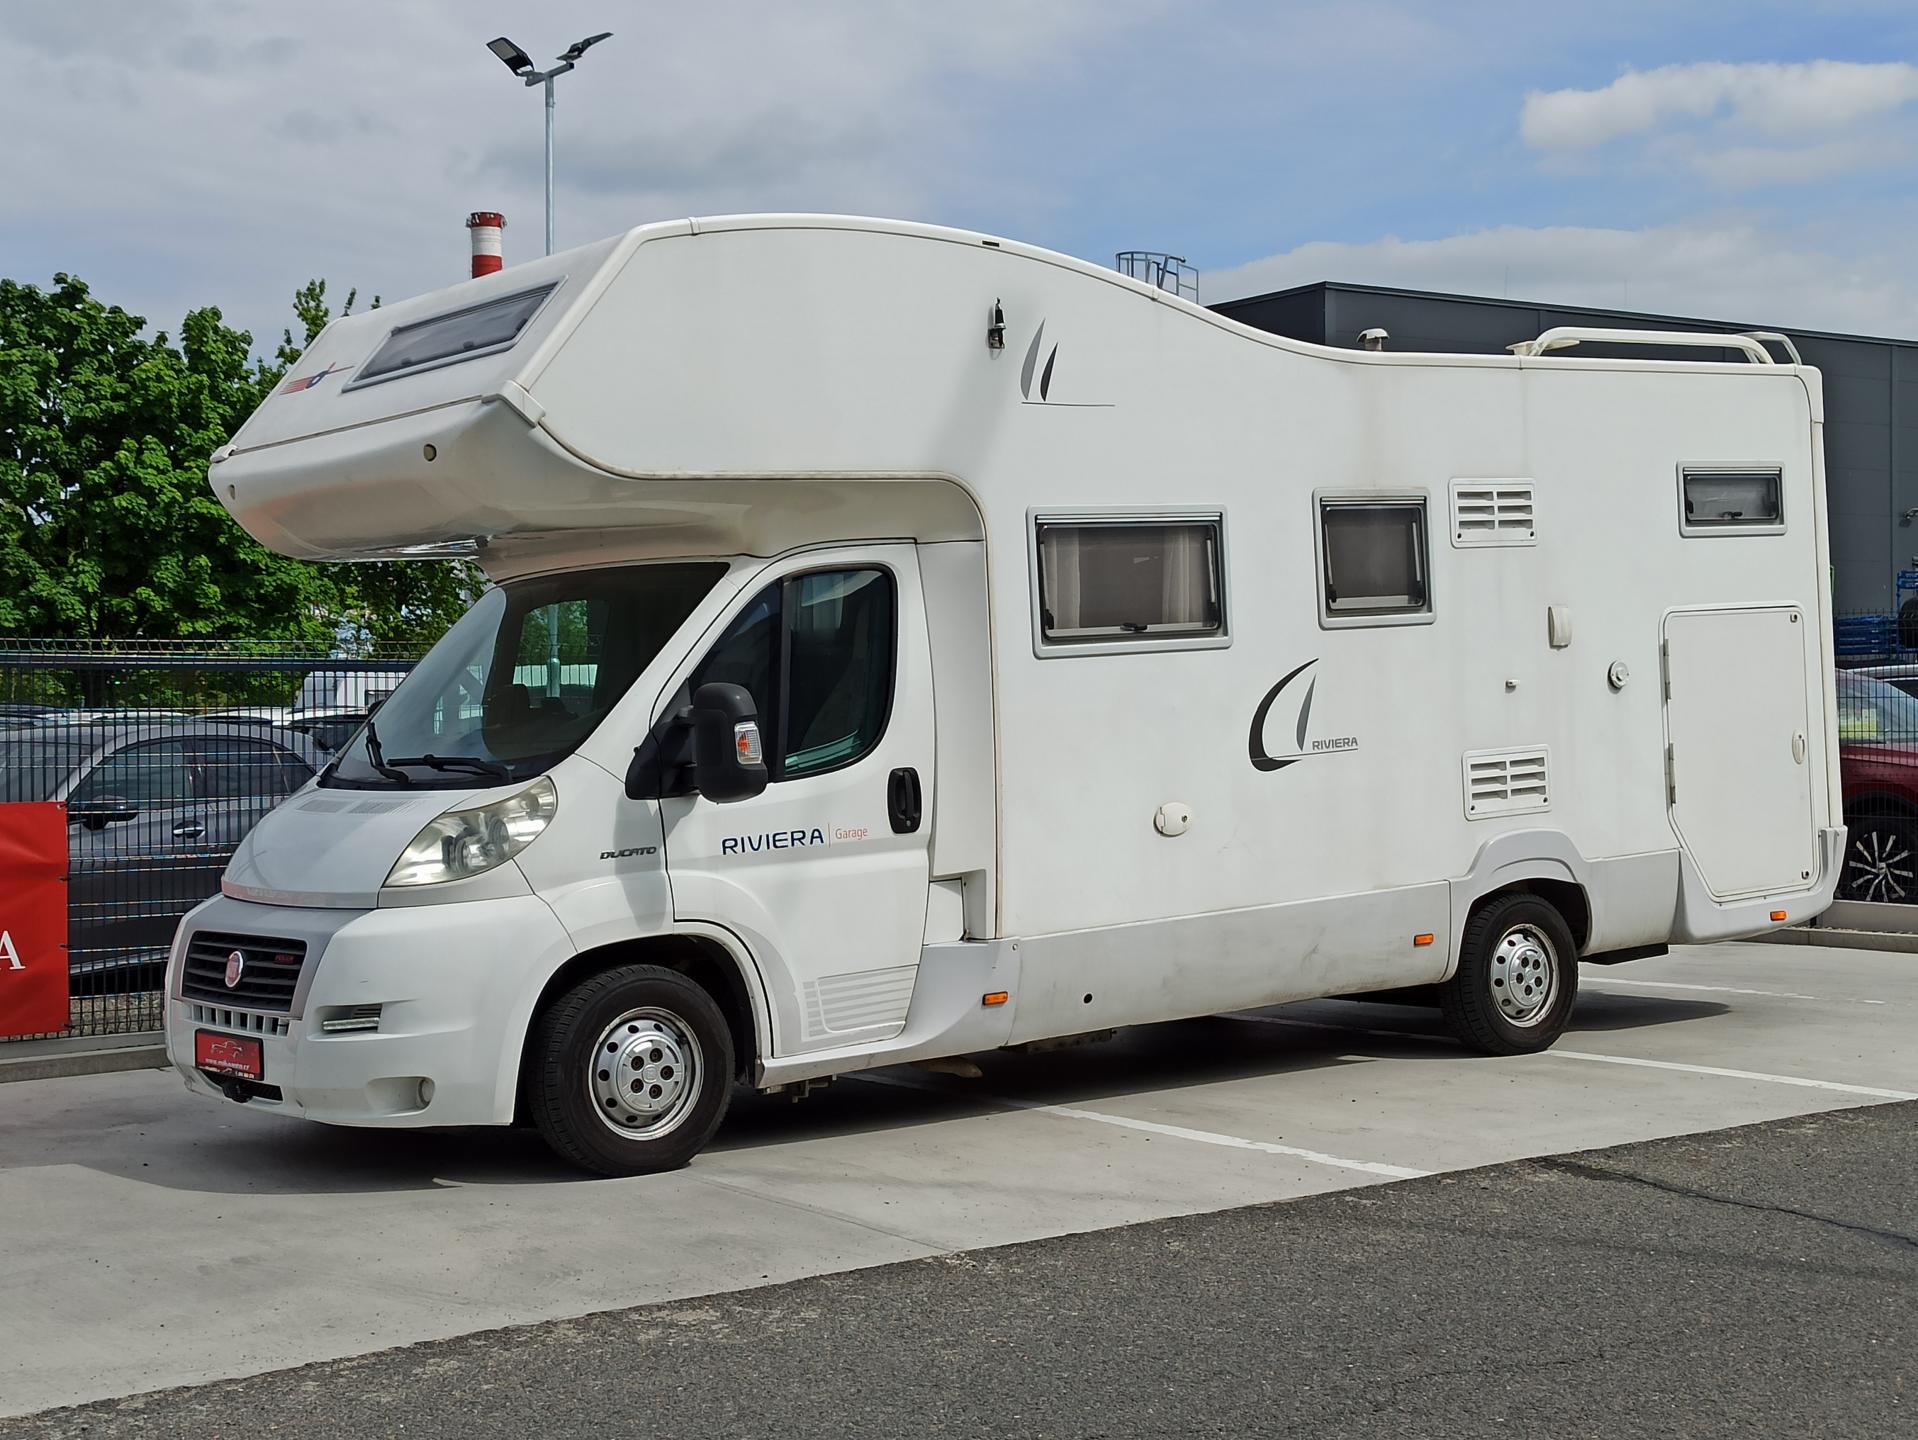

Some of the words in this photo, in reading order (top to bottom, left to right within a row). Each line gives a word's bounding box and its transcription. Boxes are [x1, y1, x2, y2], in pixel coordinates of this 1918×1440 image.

[1312, 736, 1359, 751] RIVIERA
[721, 828, 825, 856] RIVIERA
[835, 827, 868, 841] Garage
[600, 846, 657, 860] DUCATO
